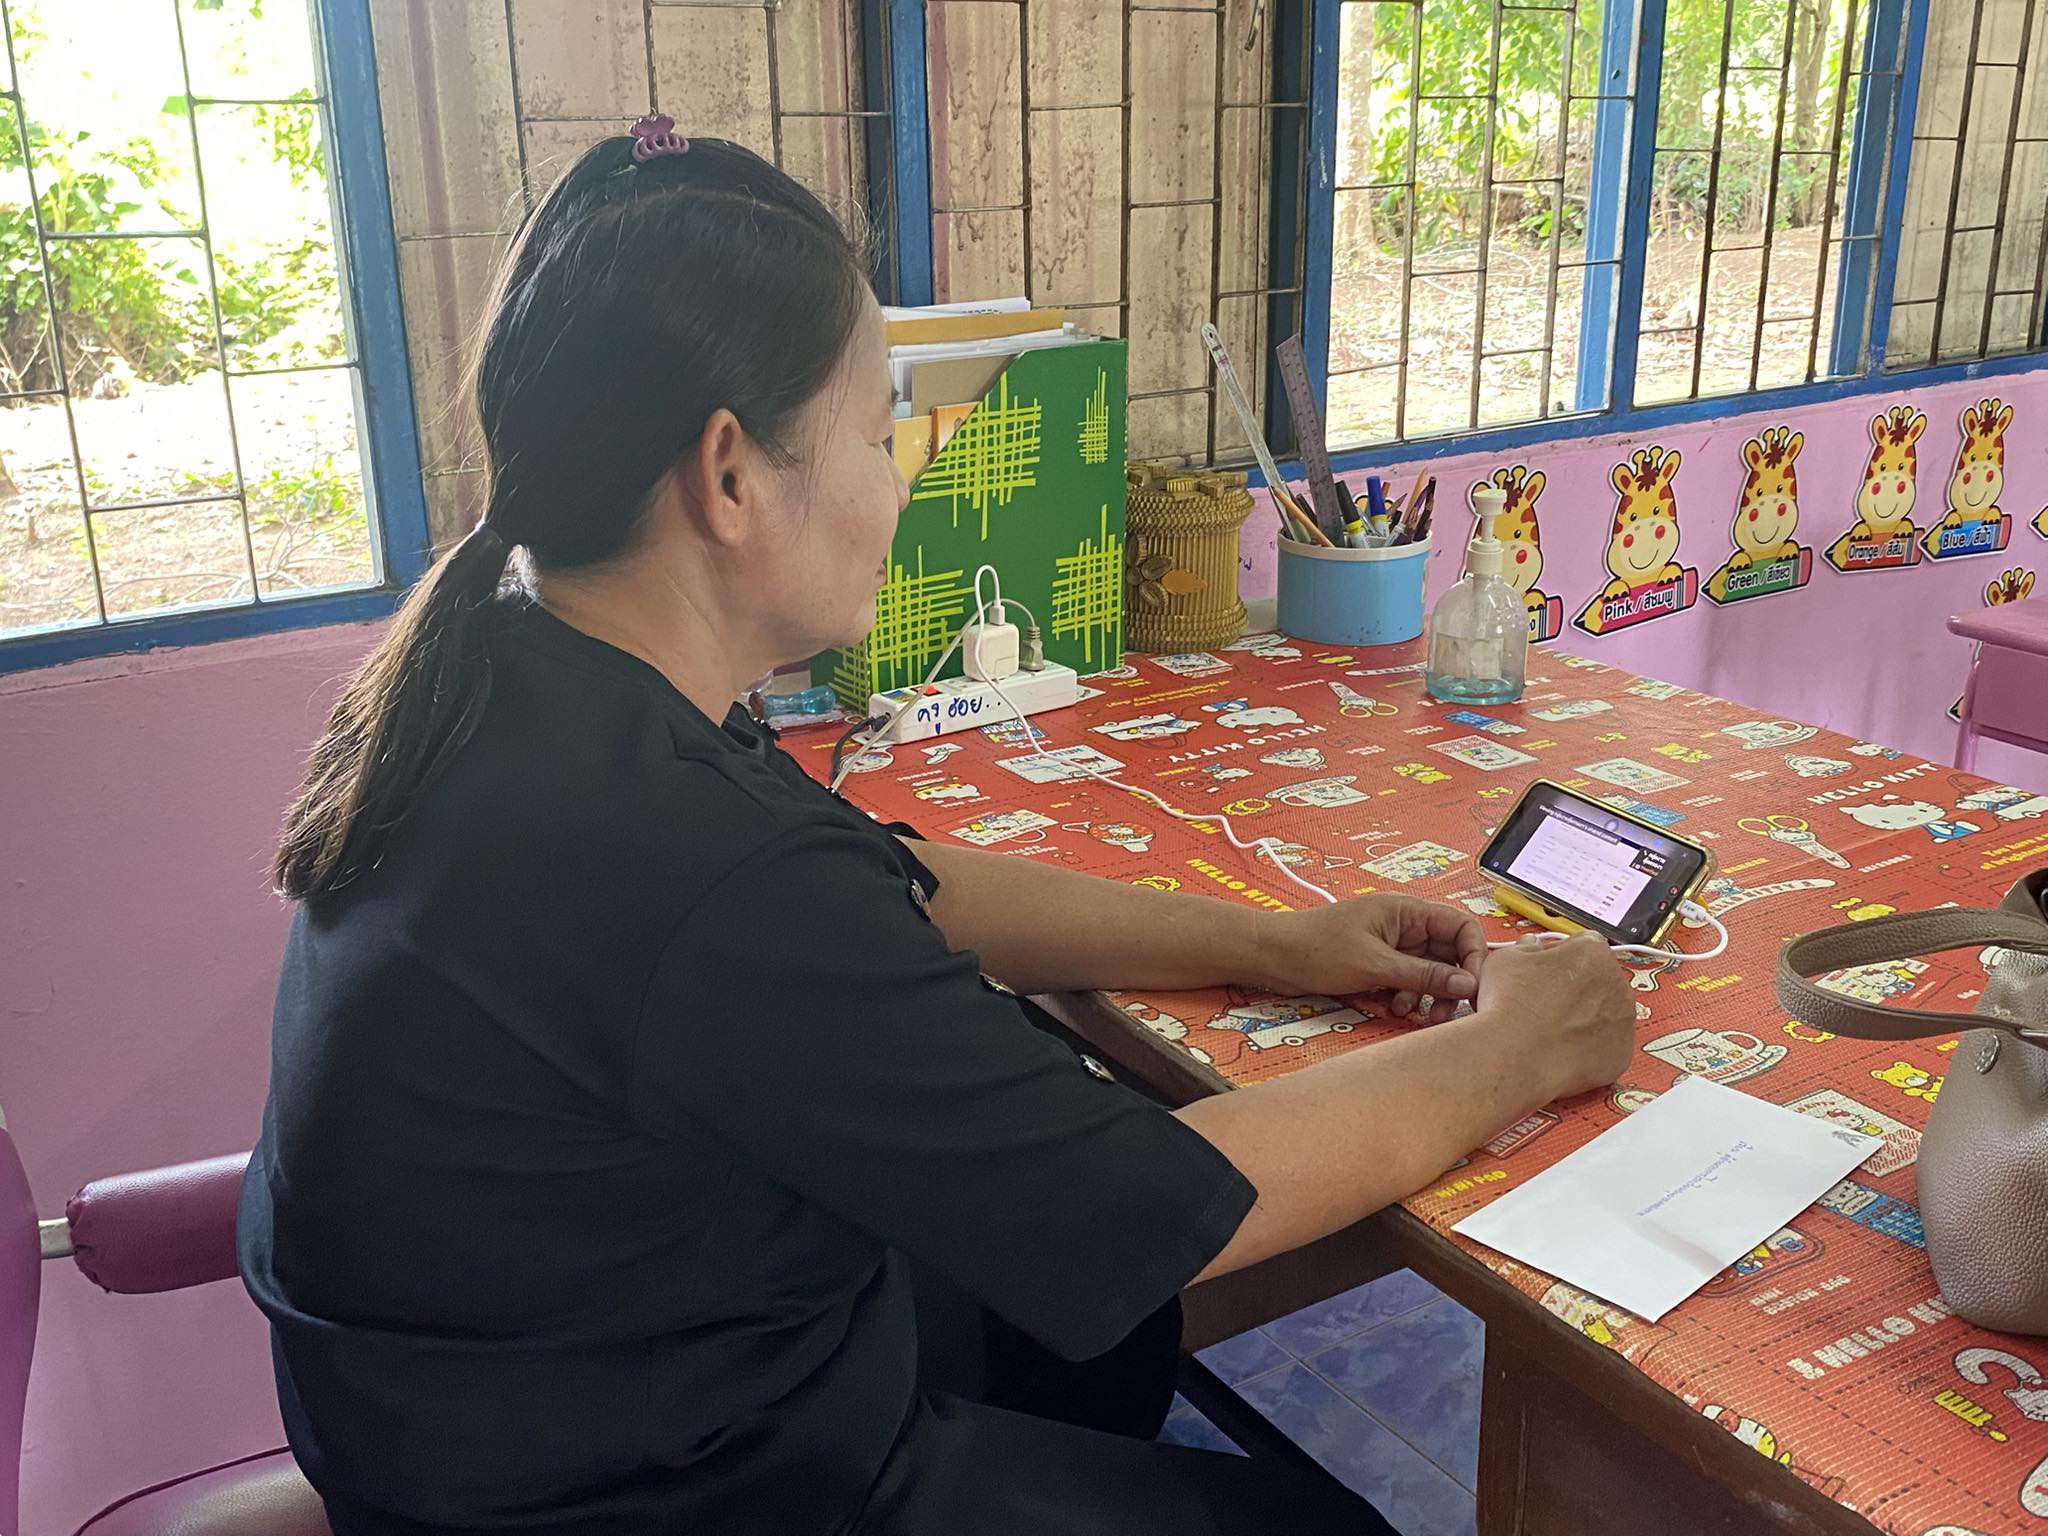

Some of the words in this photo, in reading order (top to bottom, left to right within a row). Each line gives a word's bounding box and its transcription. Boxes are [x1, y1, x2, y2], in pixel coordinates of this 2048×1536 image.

[1942, 531, 1965, 549] Blue
[1848, 544, 1879, 562] Orange
[1727, 573, 1759, 591] Green
[1604, 599, 1633, 621] Pink
[1247, 724, 1327, 745] HELLO
[1168, 742, 1245, 763] KITTY
[1806, 780, 1885, 805] HELLO
[1880, 761, 1938, 784] KITT
[1186, 858, 1247, 890] HELLO
[1812, 1315, 1916, 1369] HELLO
